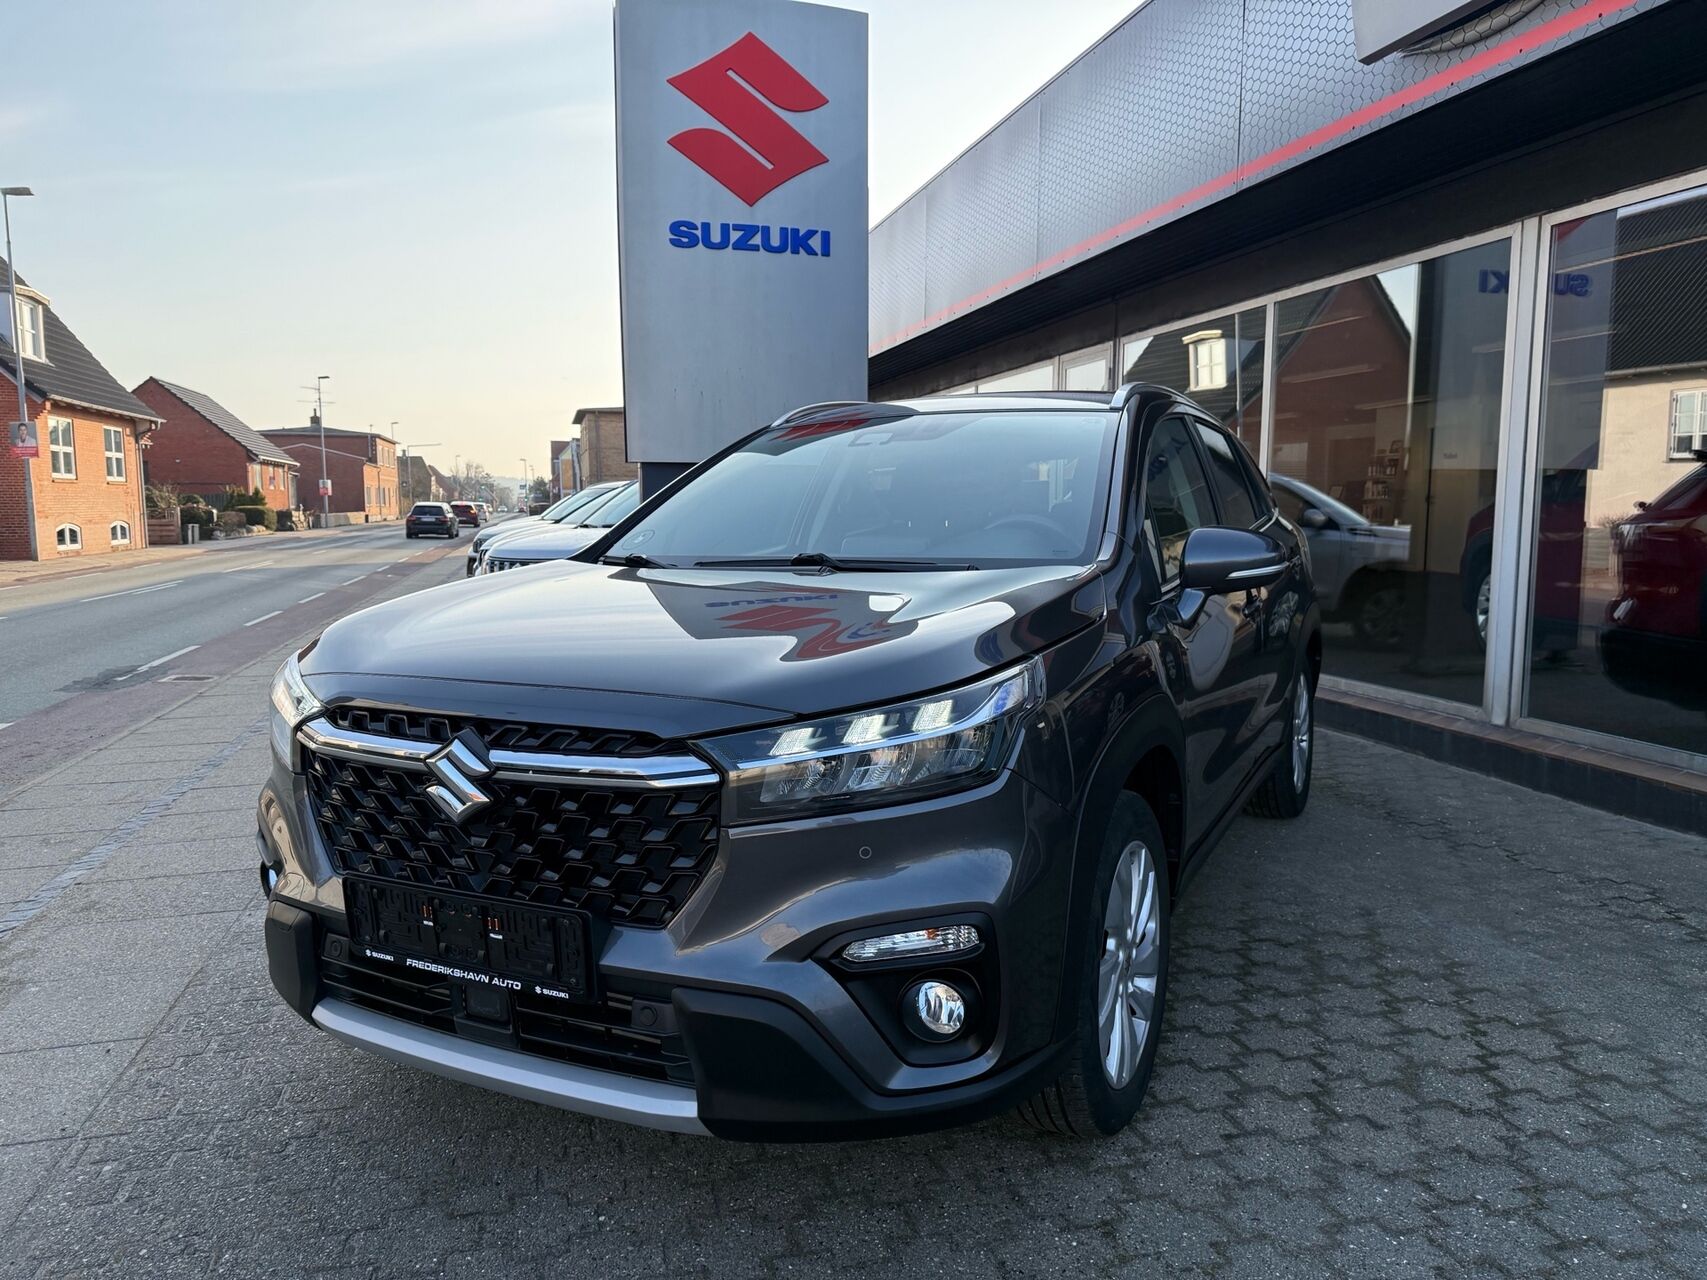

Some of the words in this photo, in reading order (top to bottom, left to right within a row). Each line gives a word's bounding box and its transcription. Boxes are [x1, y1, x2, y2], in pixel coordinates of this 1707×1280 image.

[669, 220, 831, 257] SUZUKI
[372, 951, 394, 961] SUZUKI
[406, 959, 489, 983] FREDERIKSHAVN
[492, 977, 521, 990] AUTO
[542, 988, 569, 998] SUZUKI
